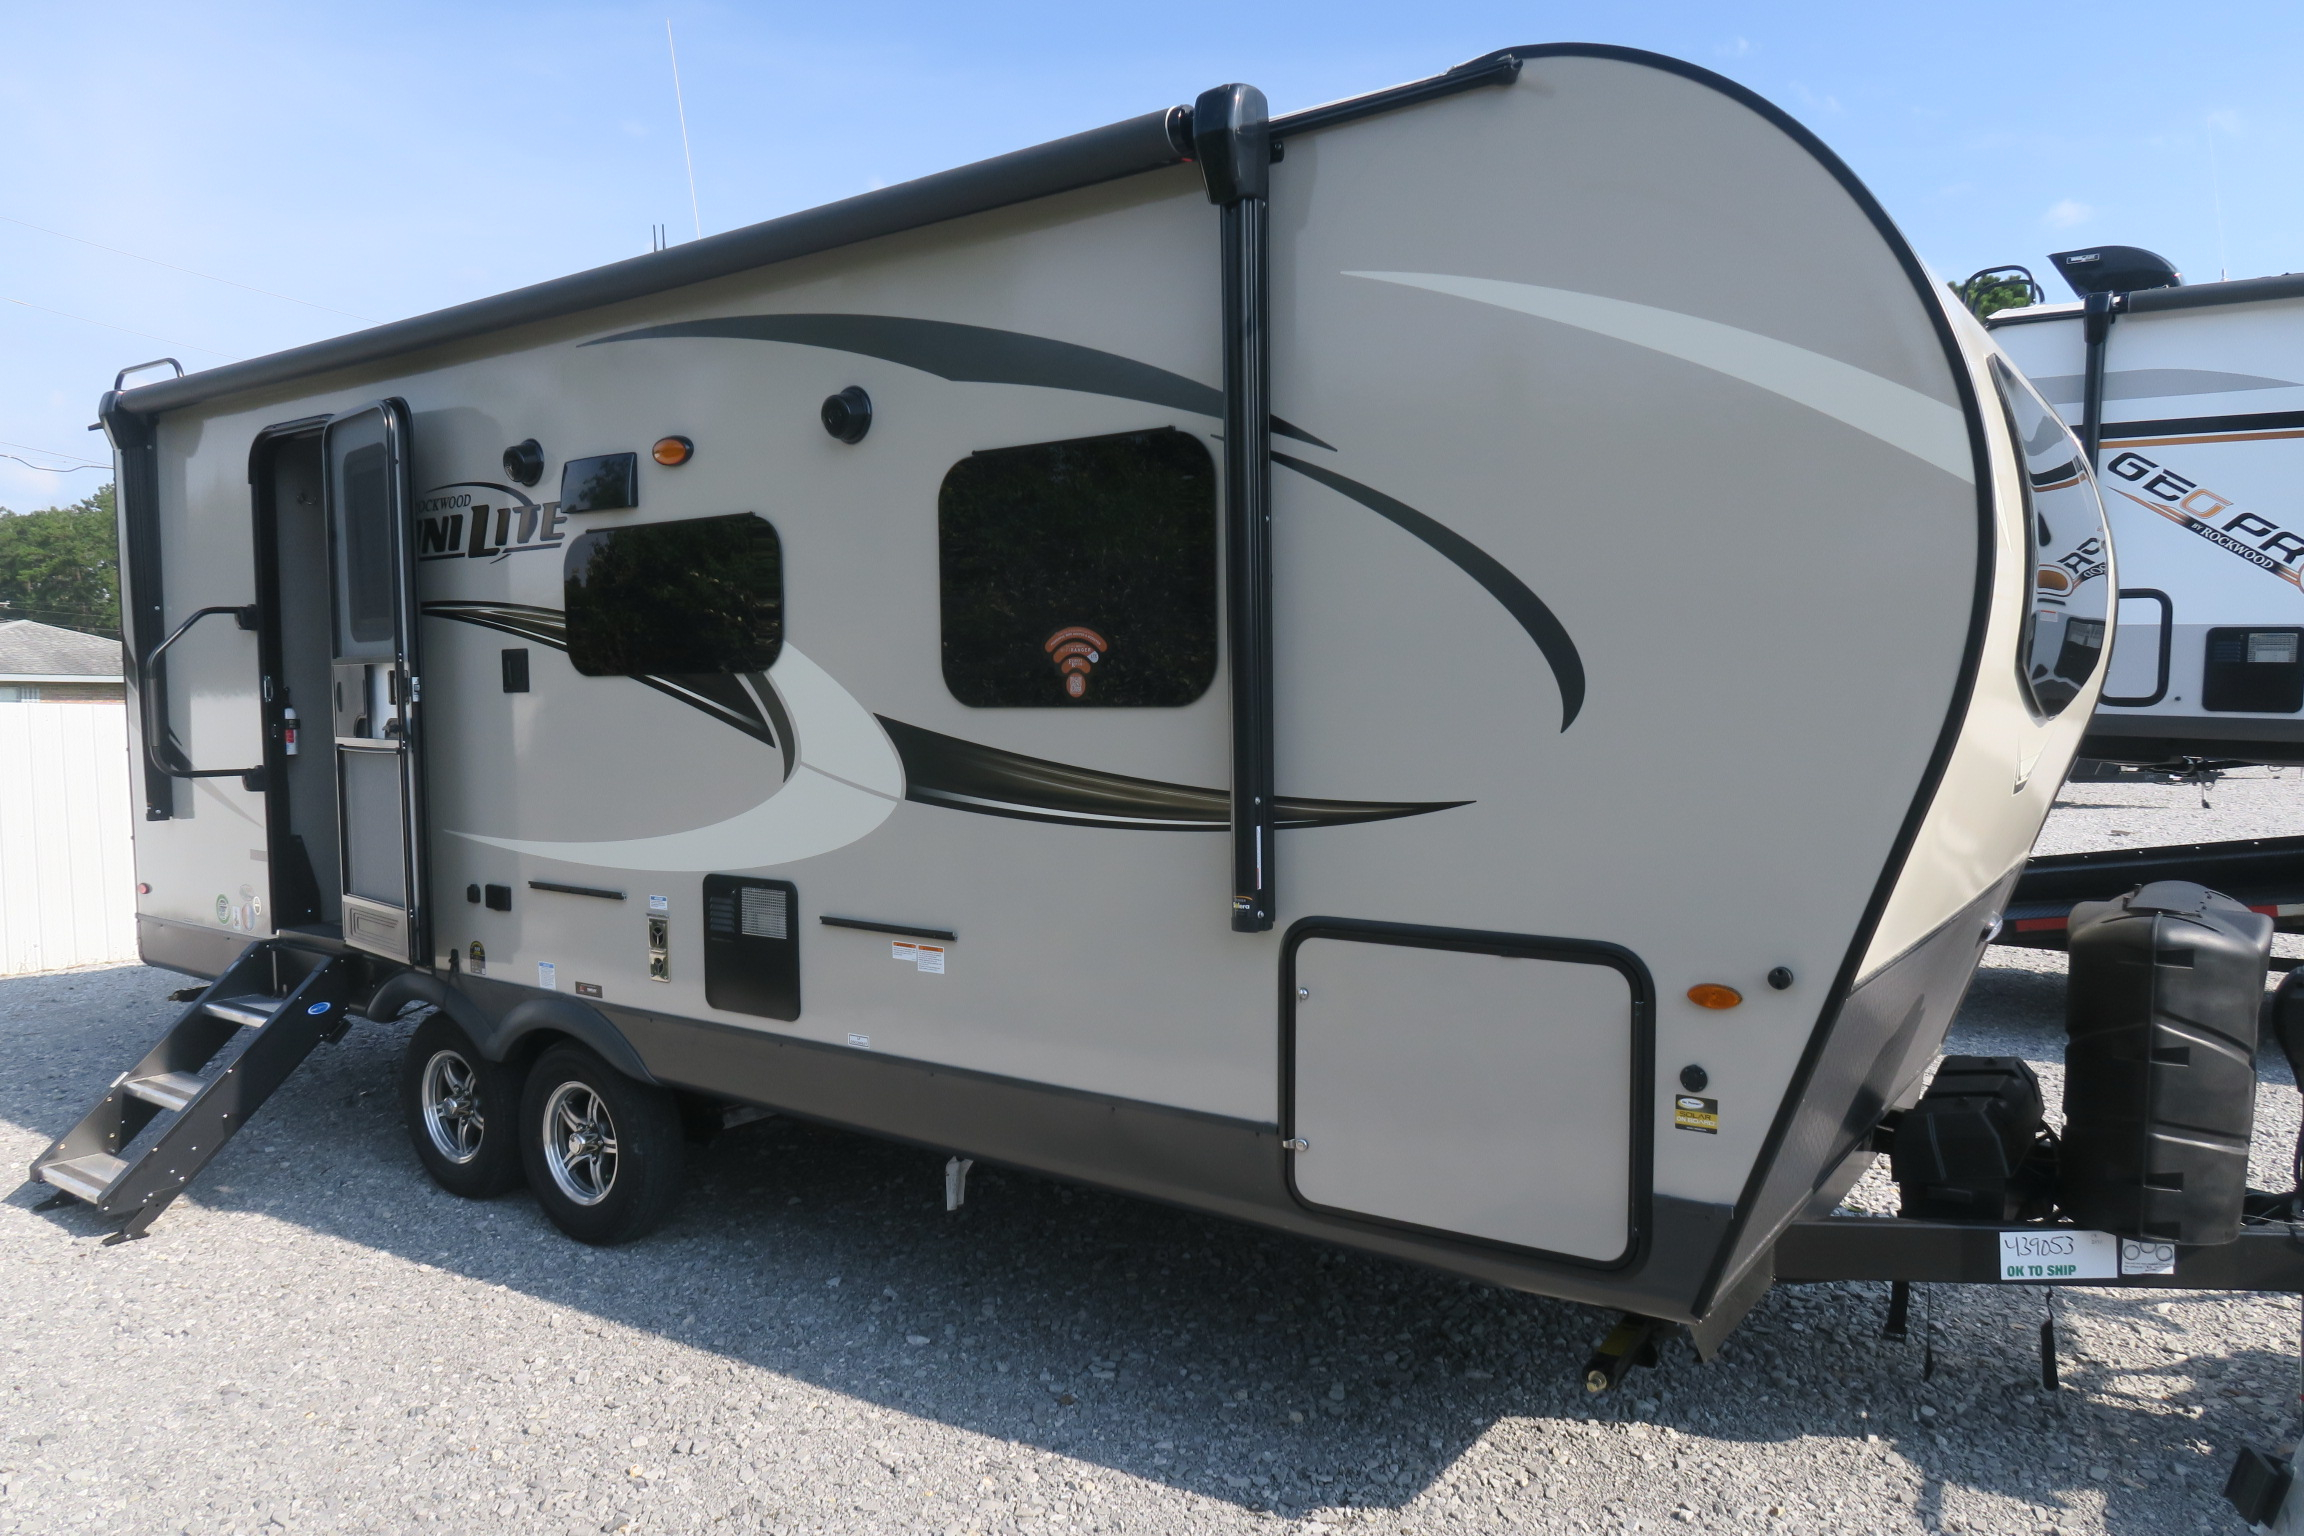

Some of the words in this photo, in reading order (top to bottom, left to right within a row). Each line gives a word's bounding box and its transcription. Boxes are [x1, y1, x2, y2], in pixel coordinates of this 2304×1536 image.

[2107, 452, 2234, 519] GEO
[417, 494, 471, 514] OCKWOOD
[2191, 522, 2203, 531] BY
[2200, 526, 2274, 570] ROCKWOOD
[2221, 512, 2304, 568] PR
[2004, 1236, 2074, 1257] 439053
[2007, 1265, 2024, 1278] OK
[2029, 1265, 2043, 1277] TO
[2047, 1264, 2076, 1277] SHIP
